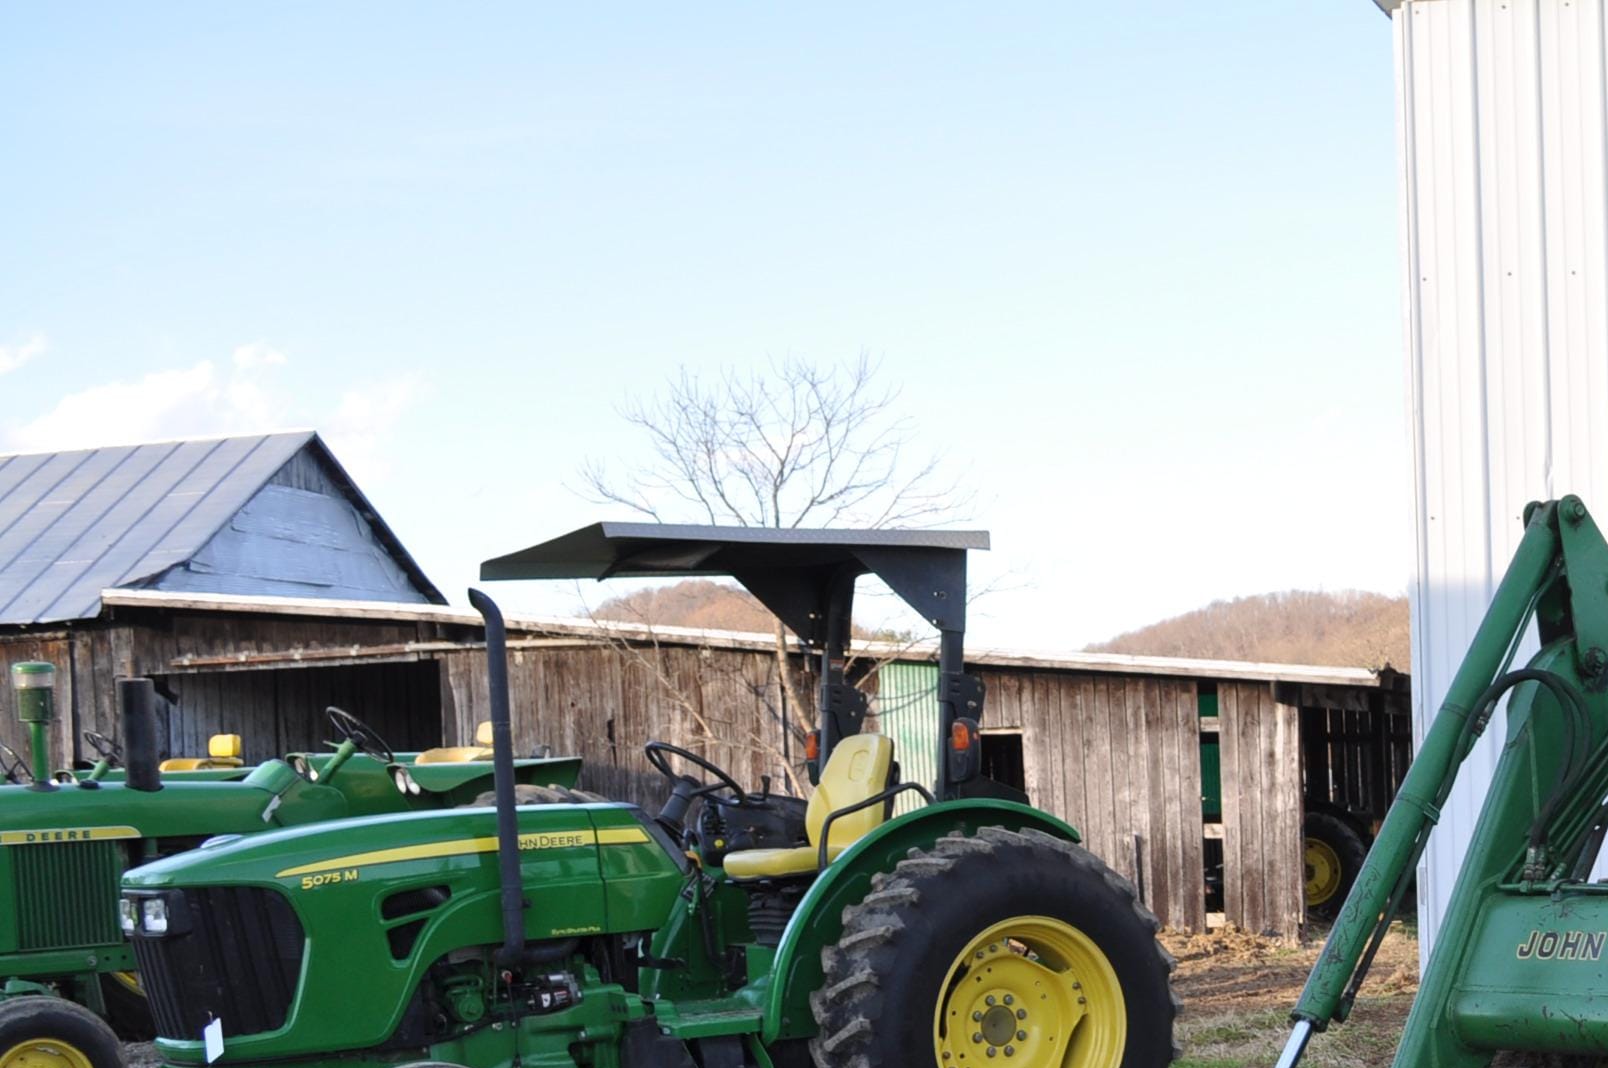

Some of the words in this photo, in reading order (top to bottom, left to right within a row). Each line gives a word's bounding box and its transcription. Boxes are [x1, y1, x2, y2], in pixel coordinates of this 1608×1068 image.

[26, 830, 91, 842] DEERE
[539, 835, 582, 848] DEERE
[302, 871, 341, 889] 5075
[344, 869, 358, 881] M
[1516, 930, 1607, 961] JOHN
